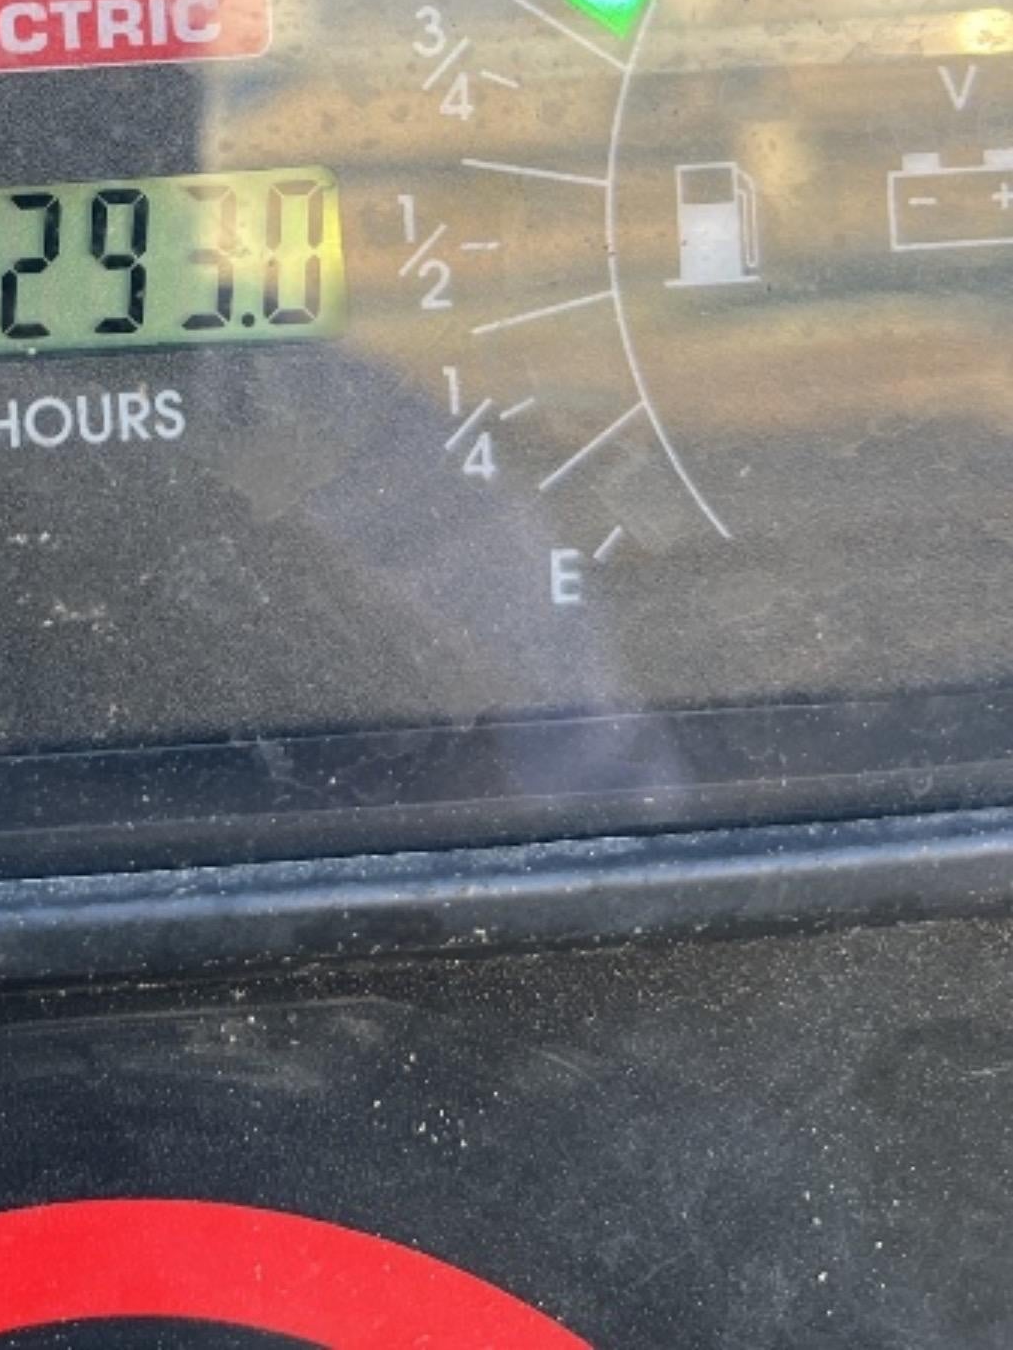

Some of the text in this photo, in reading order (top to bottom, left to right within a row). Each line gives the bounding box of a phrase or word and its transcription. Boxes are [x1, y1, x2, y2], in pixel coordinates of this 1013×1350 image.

[939, 65, 978, 111] V
[1, 179, 326, 340] 293.0
[551, 549, 582, 604] E
